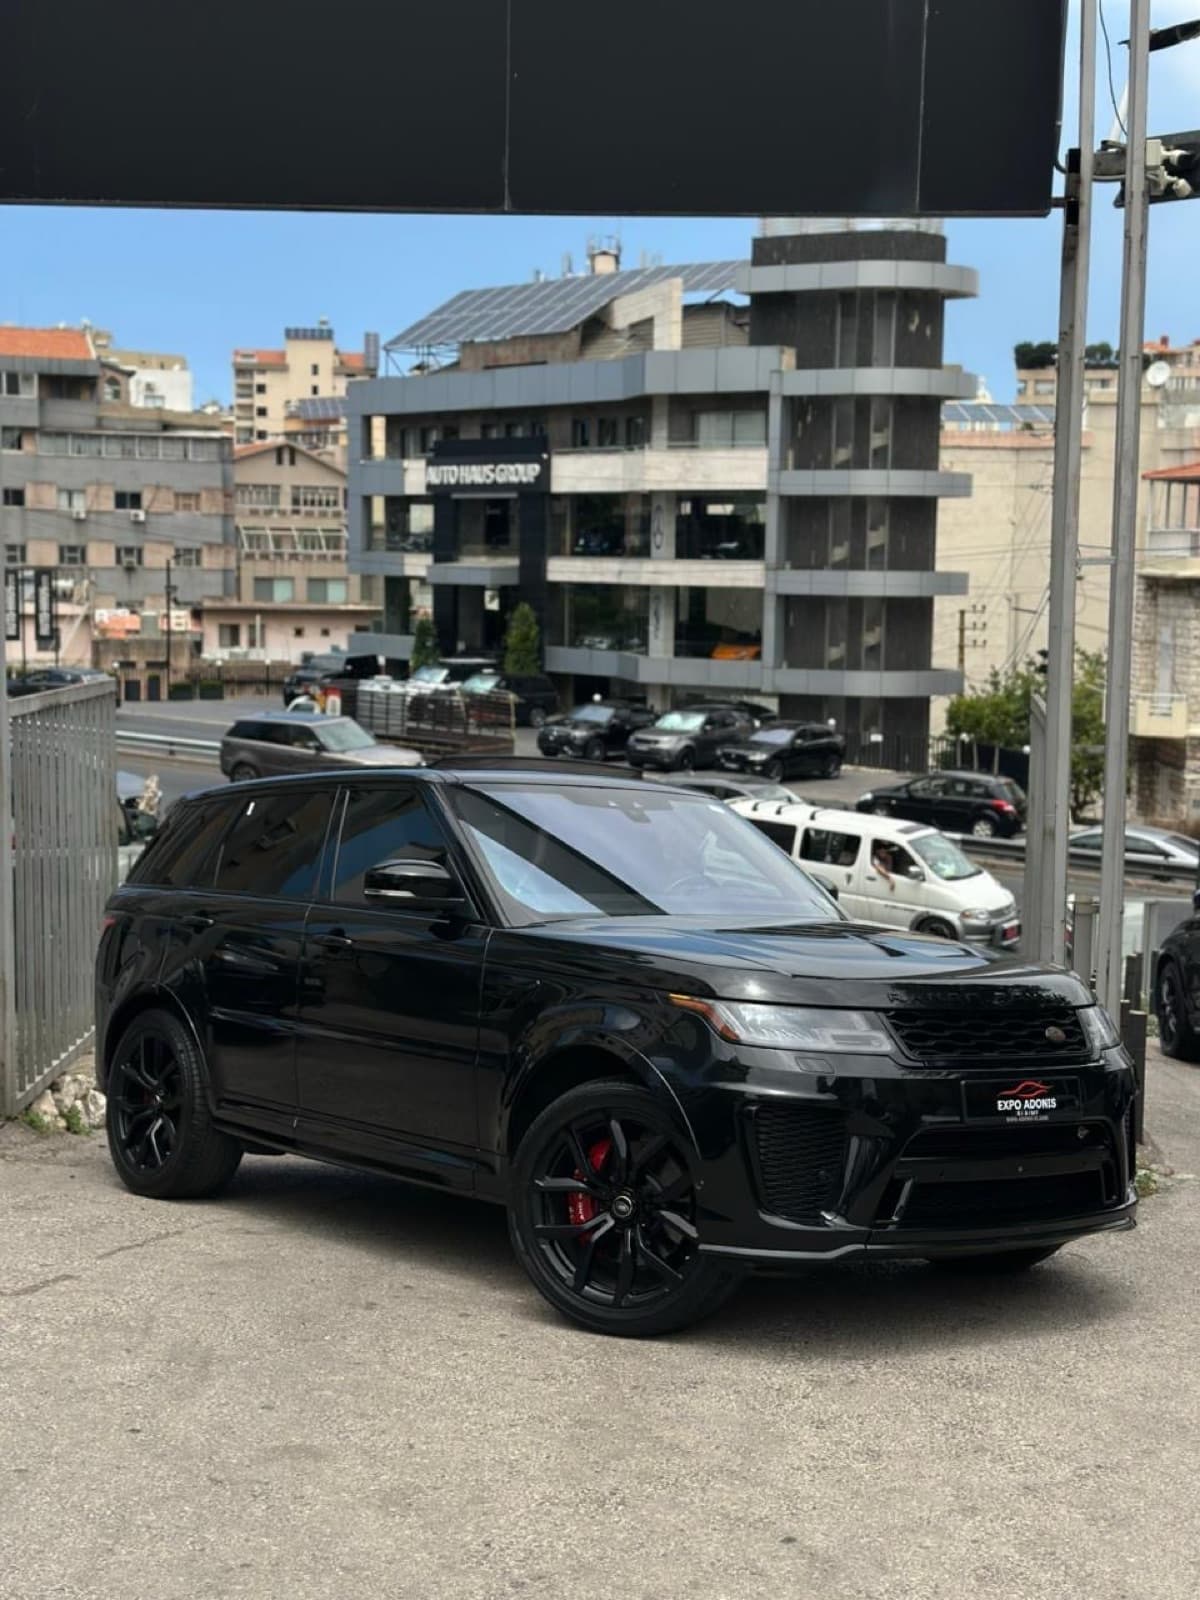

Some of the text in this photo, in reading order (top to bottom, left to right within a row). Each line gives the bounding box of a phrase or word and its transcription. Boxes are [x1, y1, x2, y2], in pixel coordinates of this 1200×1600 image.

[427, 463, 540, 484] AUTO HAUS GROUP
[997, 1098, 1056, 1110] EXPO ADONIS
